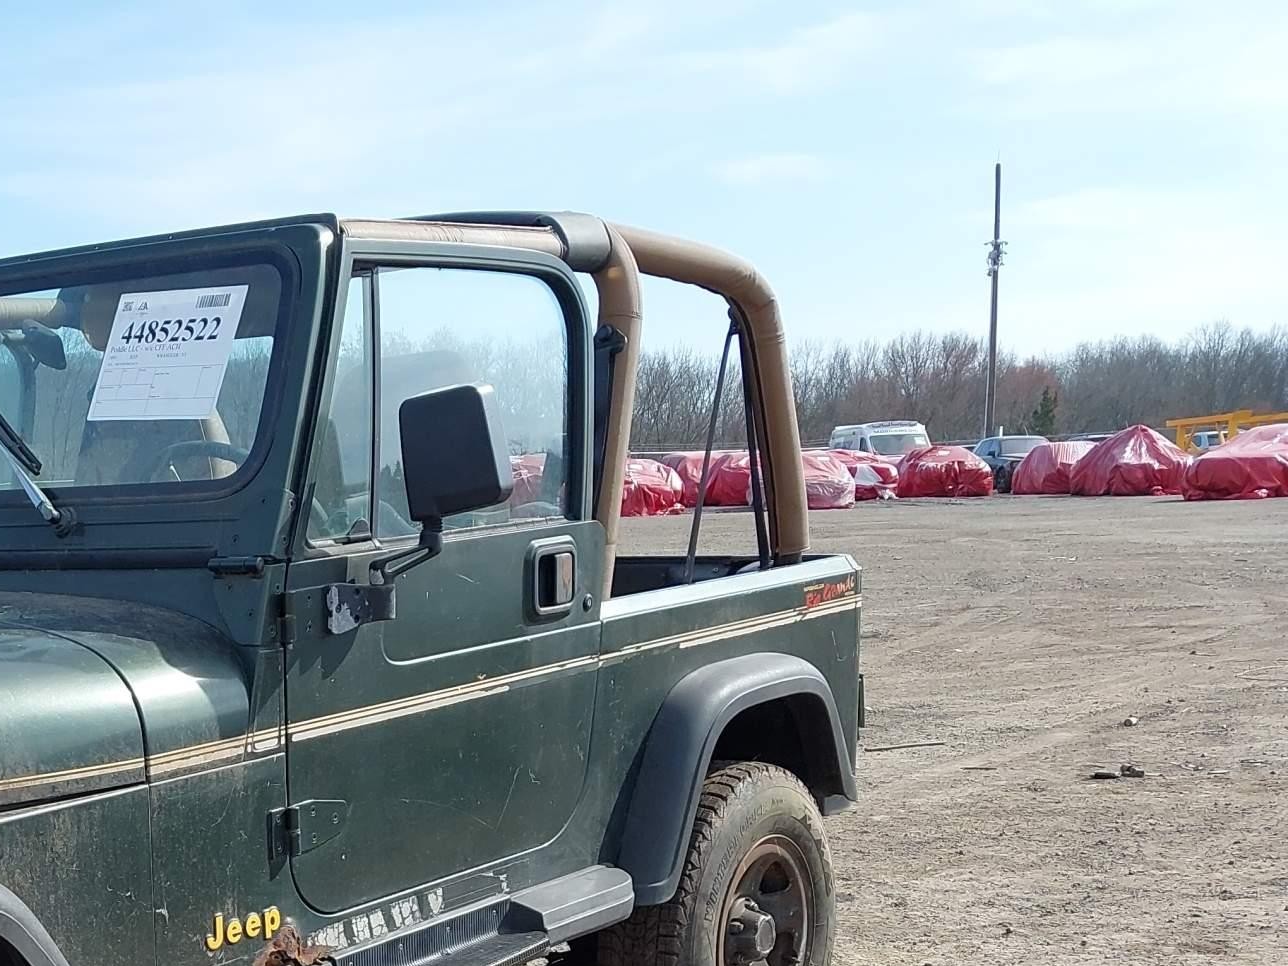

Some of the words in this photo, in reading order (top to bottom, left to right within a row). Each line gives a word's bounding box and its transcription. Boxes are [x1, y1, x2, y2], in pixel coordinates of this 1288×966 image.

[121, 316, 222, 345] 44852522
[823, 573, 856, 601] Grande
[204, 905, 281, 950] Jeep
